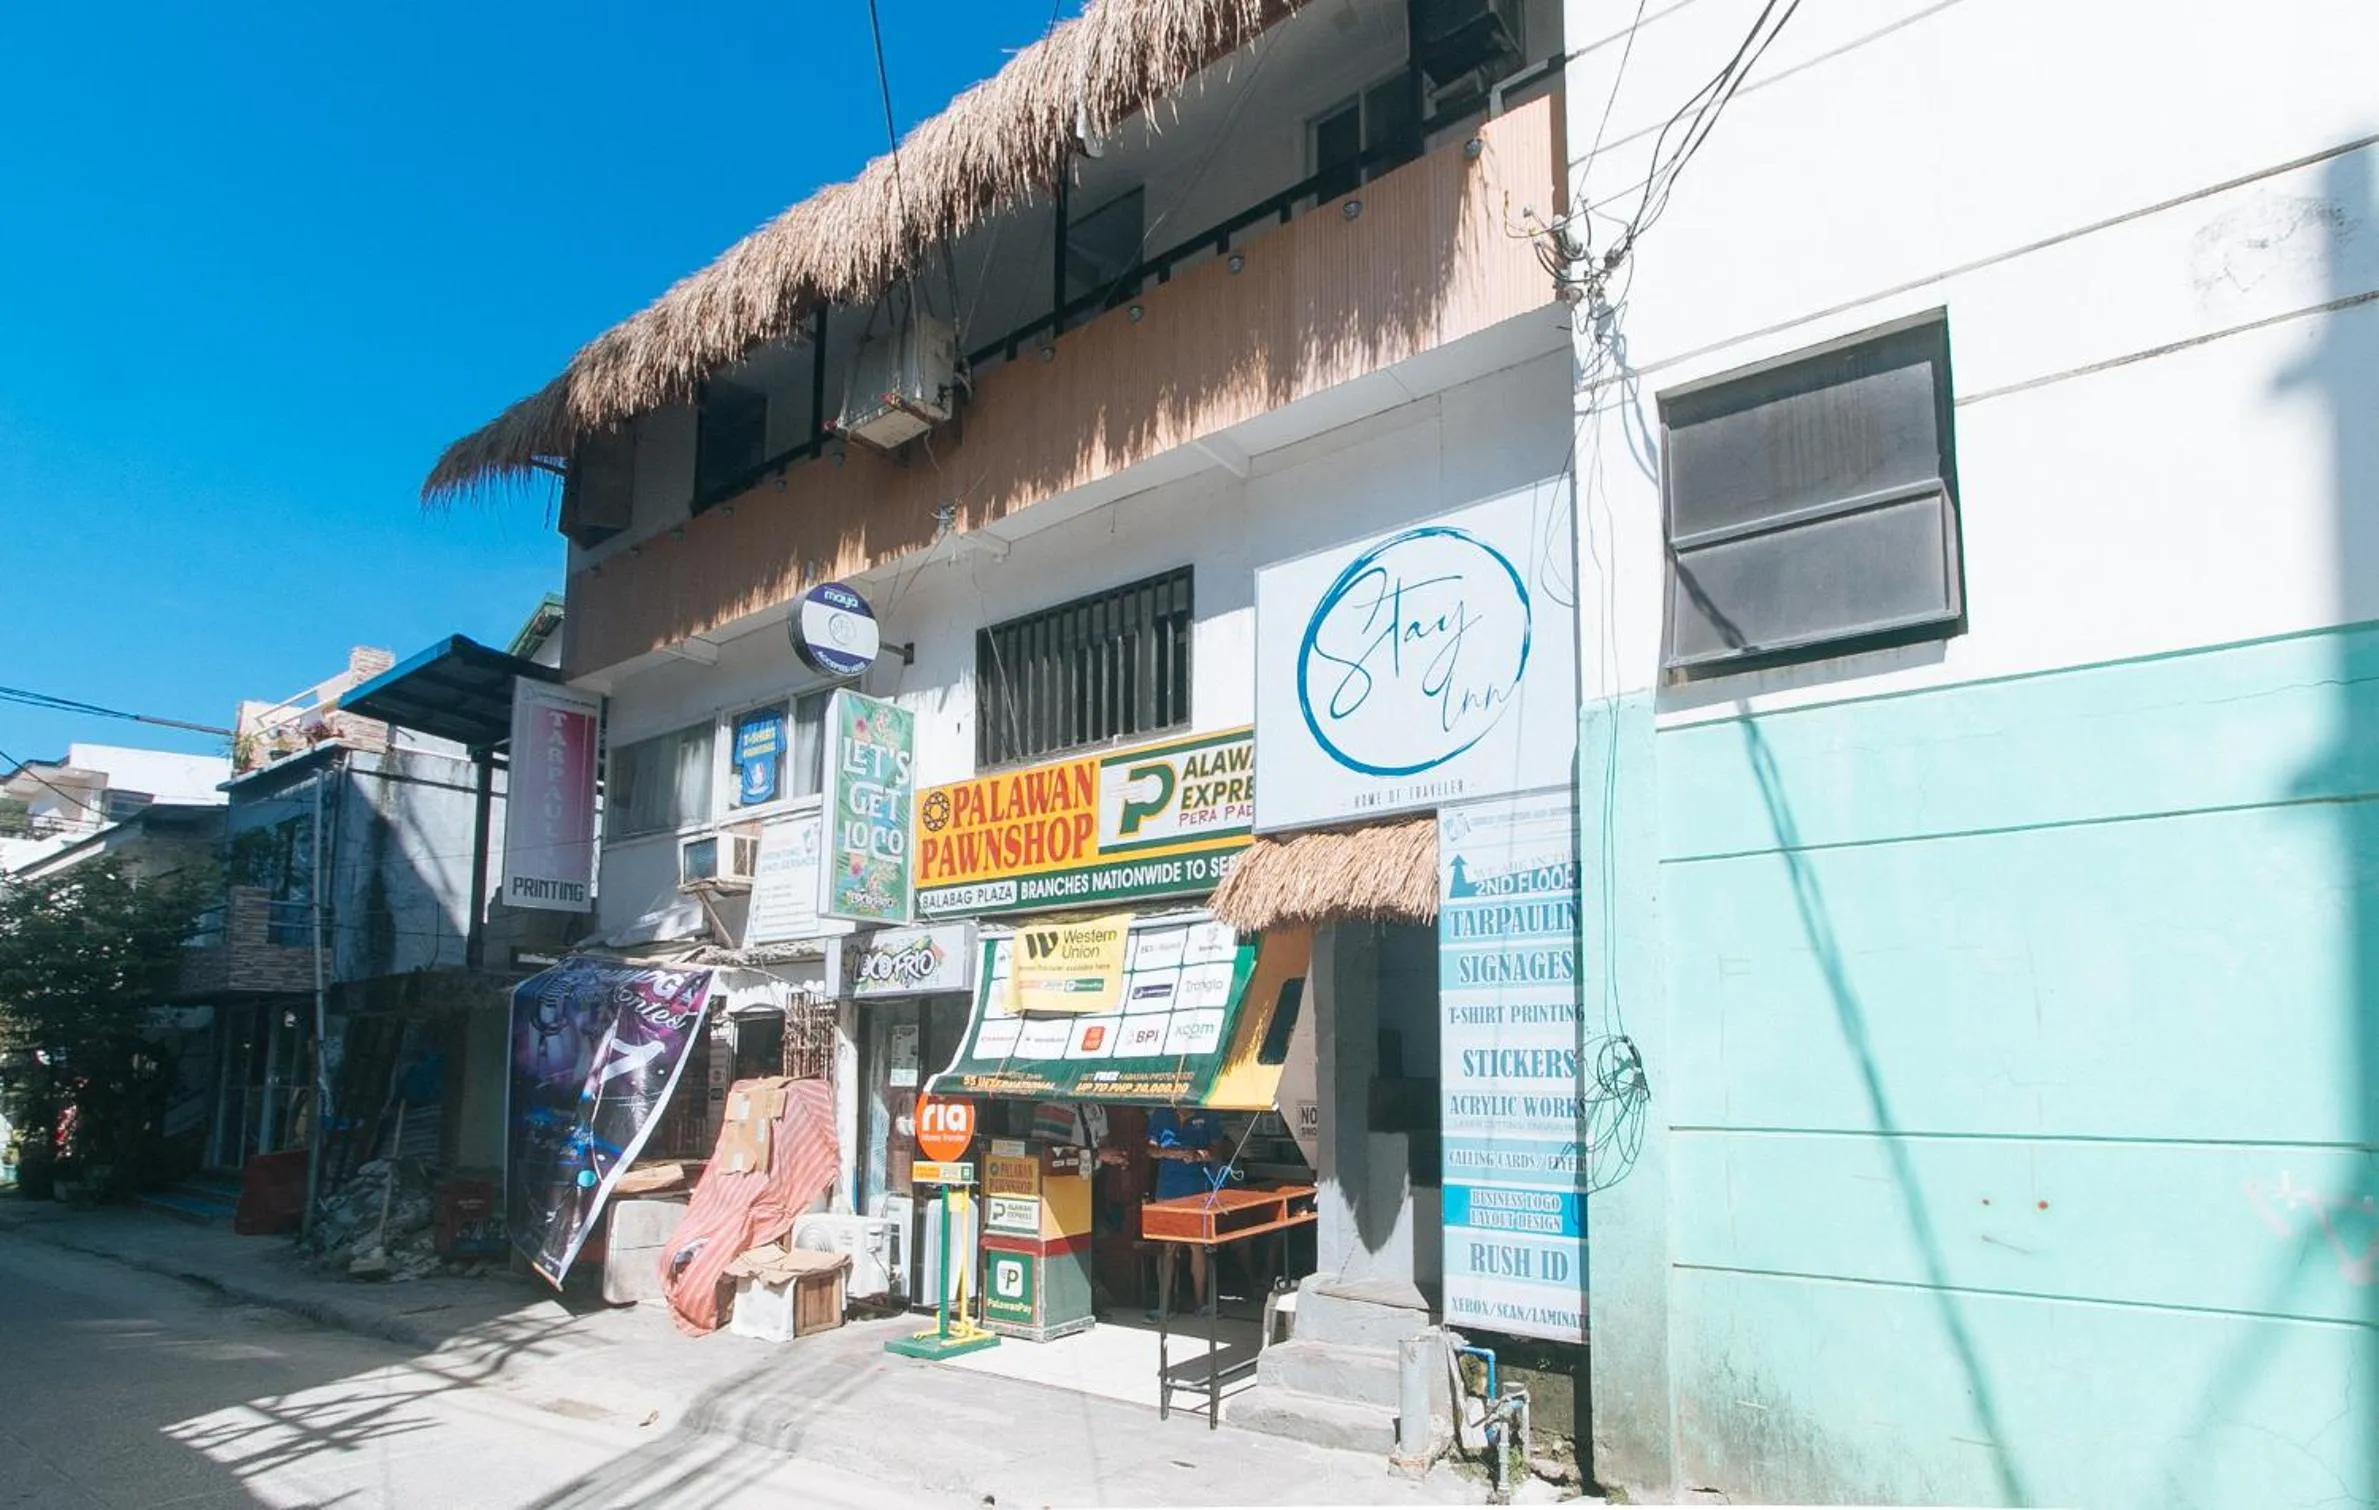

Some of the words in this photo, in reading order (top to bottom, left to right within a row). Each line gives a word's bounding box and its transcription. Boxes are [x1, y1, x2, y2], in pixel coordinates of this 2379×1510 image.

[824, 590, 859, 609] maya
[1313, 566, 1482, 719] Stay
[843, 736, 910, 785] LET'S
[1182, 745, 1253, 780] ALAW
[849, 780, 902, 820] GET
[952, 761, 1095, 830] PALAWAN
[1354, 791, 1382, 808] HOME
[1389, 788, 1401, 803] OF
[1179, 808, 1217, 827] PERA
[920, 813, 1093, 880] PAWNSHOP
[512, 875, 584, 902] PRINTING
[922, 890, 973, 910] BALABAG
[978, 885, 1013, 903] PLAZA
[1021, 872, 1089, 900] BRANCHES
[1092, 861, 1181, 892] NATIONWIDE
[1185, 858, 1206, 881] TO
[1475, 878, 1514, 896] 2ND
[1063, 930, 1117, 943] Western
[1062, 946, 1100, 959] Union
[1460, 950, 1574, 983] SIGNAGES
[1449, 1006, 1505, 1024] T-SHIRT
[1511, 1003, 1585, 1023] PRINTING
[1136, 1030, 1159, 1044] BPI
[1463, 1049, 1577, 1078] STICKERS
[921, 1104, 966, 1131] ria
[1301, 1107, 1317, 1125] NO
[1450, 1095, 1517, 1116] ACRYLIC
[1524, 1096, 1586, 1120] WORKS
[1449, 1151, 1494, 1167] CALLING
[1498, 1153, 1534, 1169] CARDS
[1472, 1191, 1525, 1207] BUSINESS
[1528, 1194, 1560, 1211] LOGO
[1519, 1216, 1560, 1233] DESIGN
[1470, 1243, 1530, 1277] RUSH
[1541, 1251, 1569, 1282] ID
[987, 1298, 1032, 1316] PalawanPay
